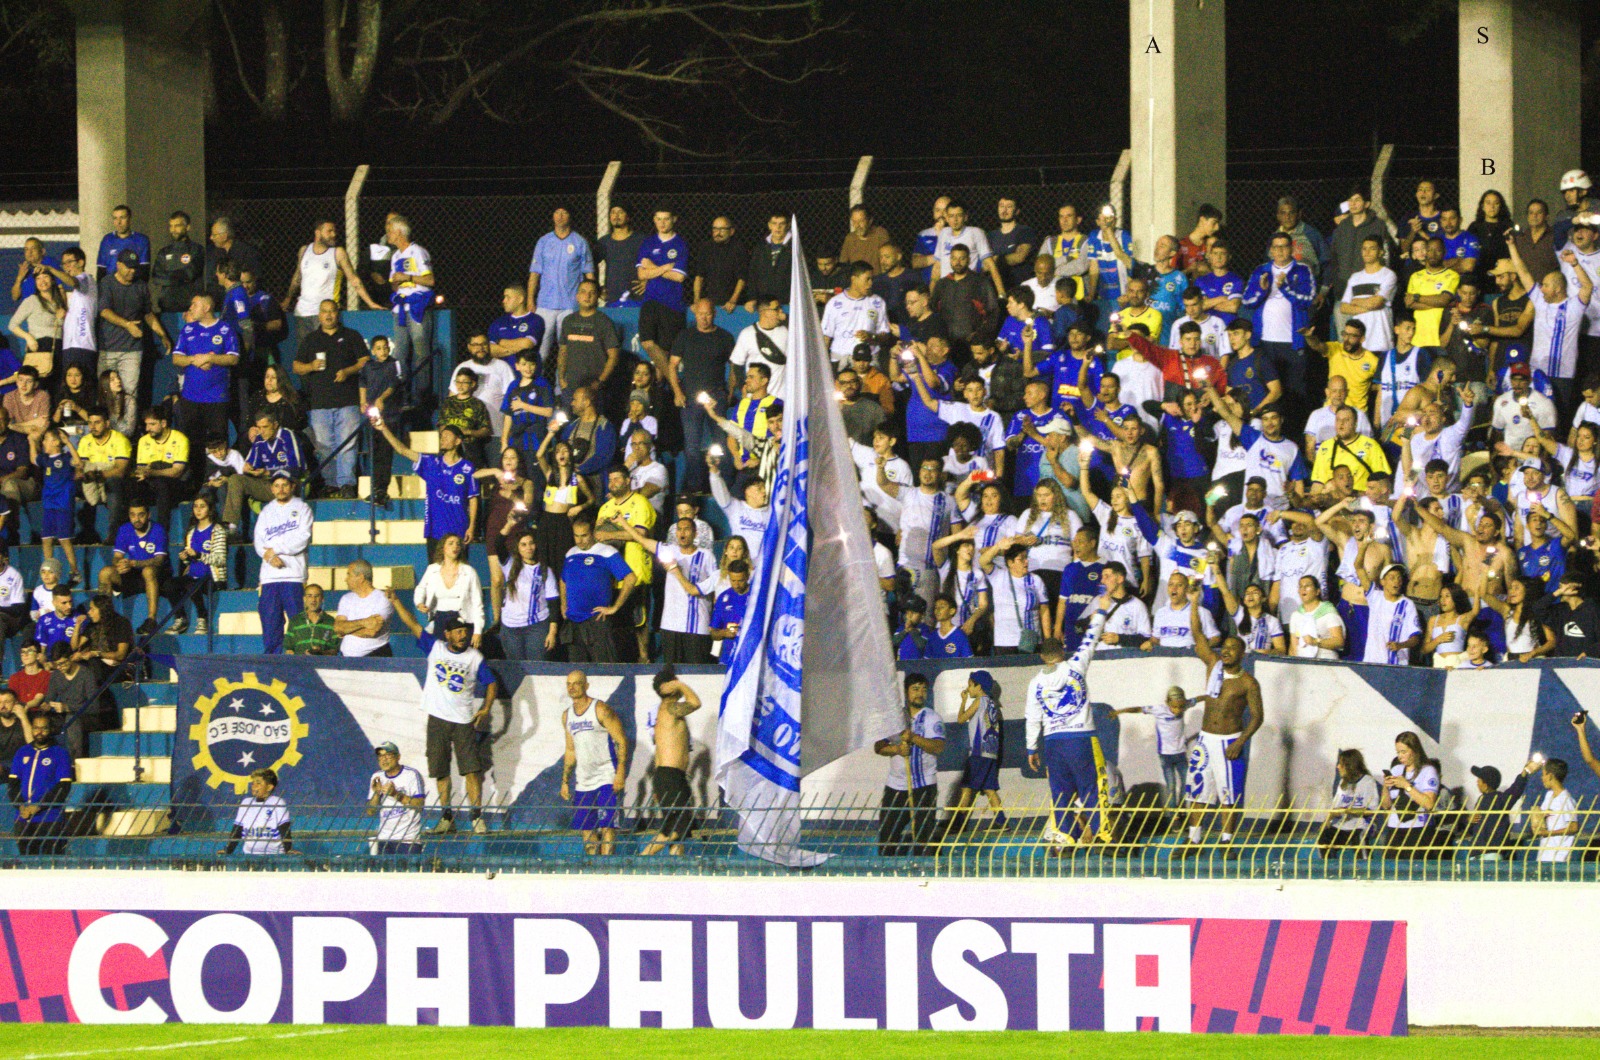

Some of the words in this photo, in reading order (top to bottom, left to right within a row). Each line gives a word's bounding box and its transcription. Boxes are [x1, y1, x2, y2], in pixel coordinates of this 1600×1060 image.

[1022, 442, 1047, 454] OSCA
[1219, 450, 1247, 461] SCAR
[436, 489, 461, 505] OCAR
[231, 721, 260, 736] JOSÉ
[264, 724, 288, 739] SÃO
[67, 913, 469, 1026] COPA
[514, 917, 1191, 1032] PAULISTA
